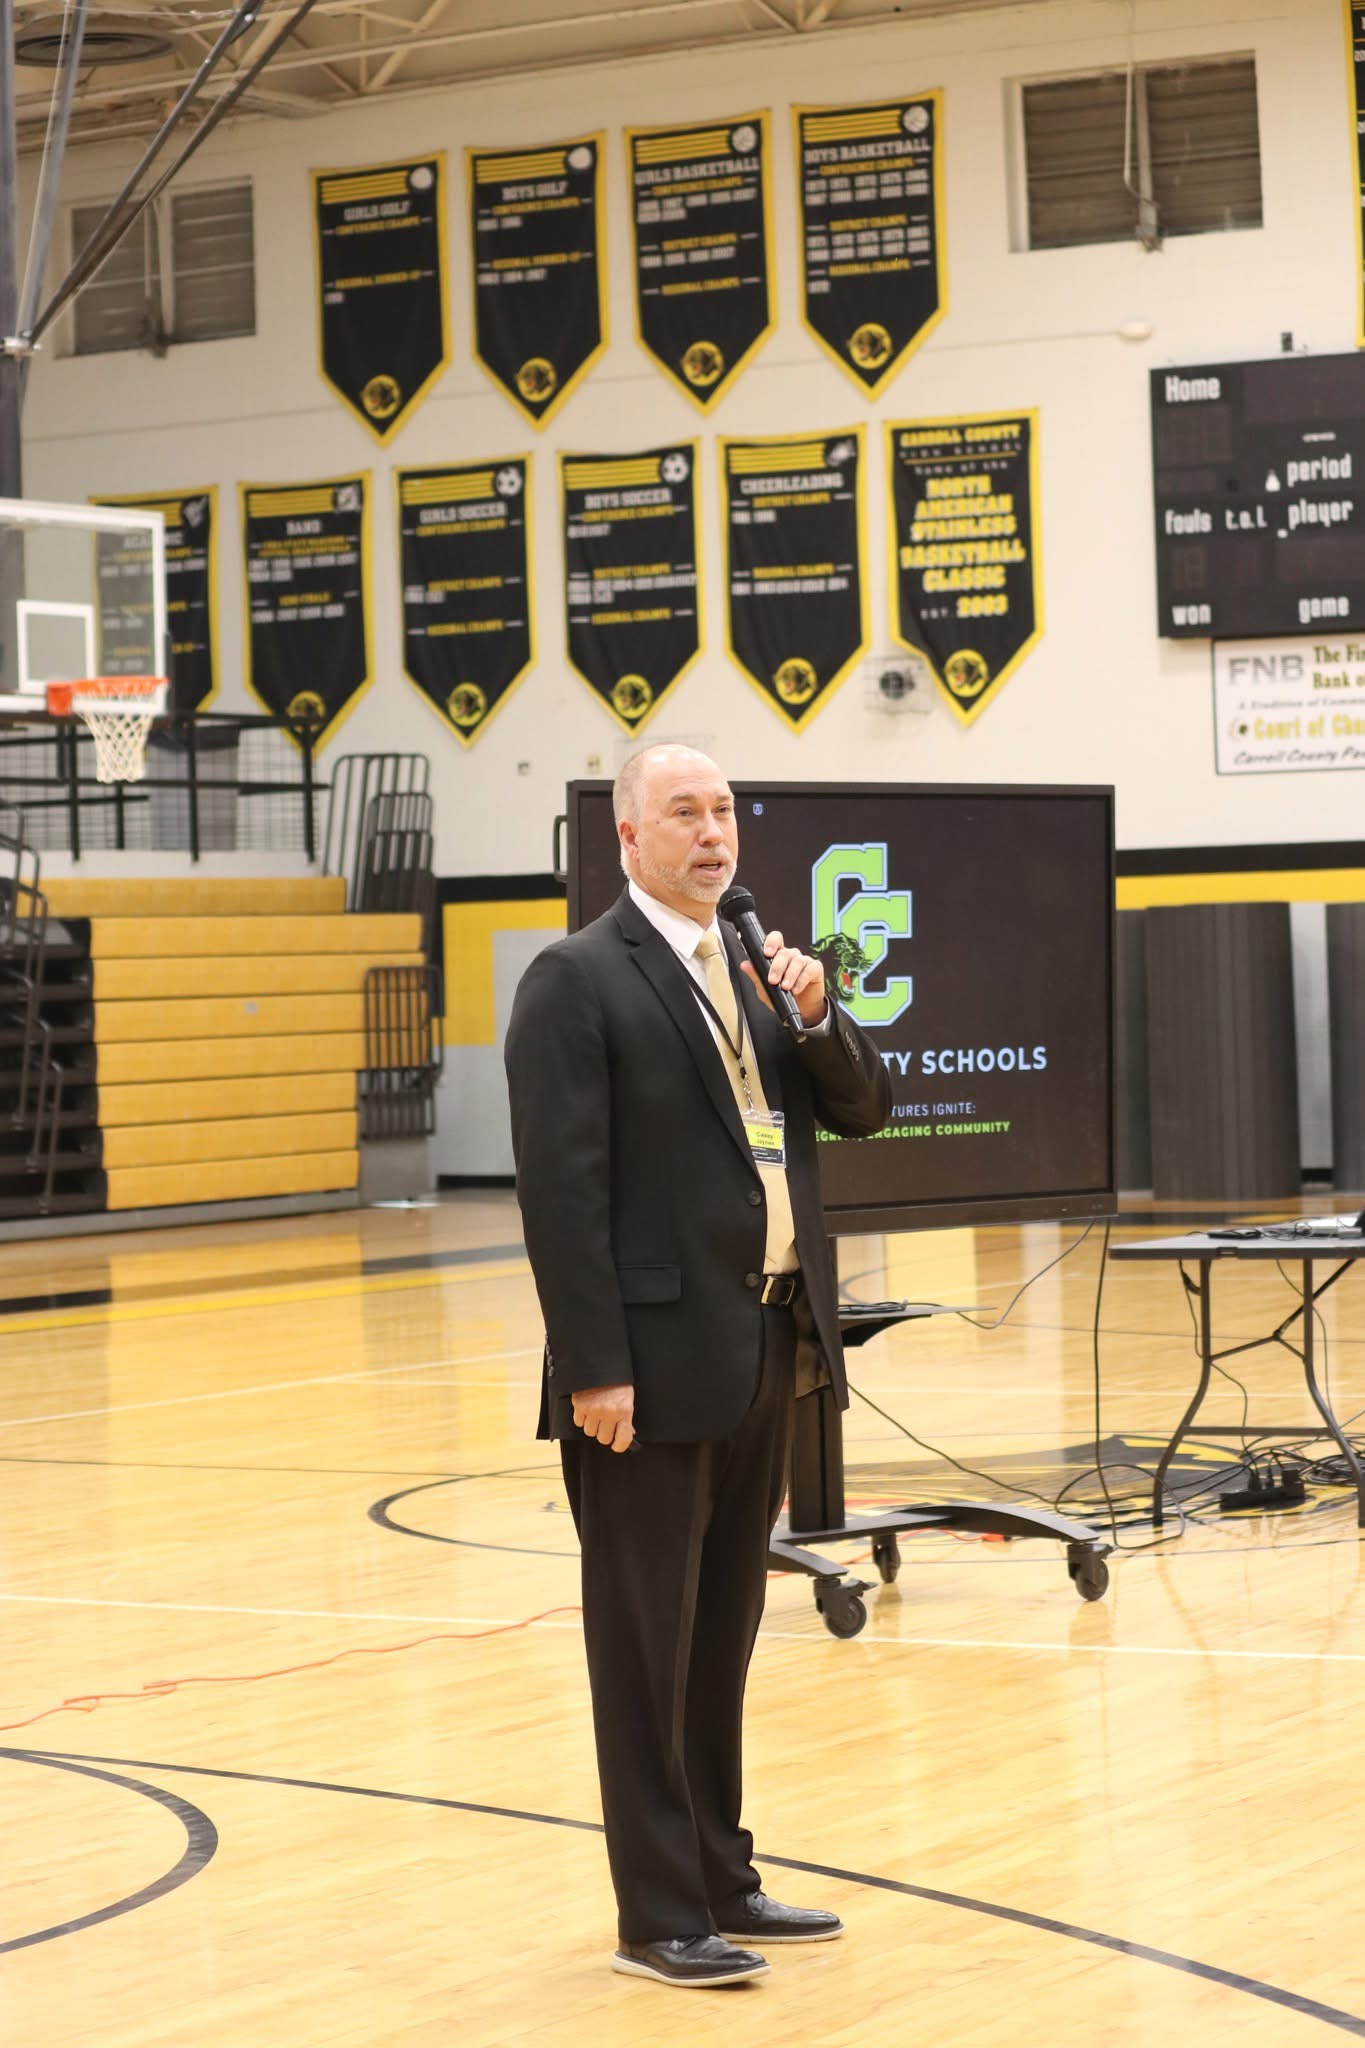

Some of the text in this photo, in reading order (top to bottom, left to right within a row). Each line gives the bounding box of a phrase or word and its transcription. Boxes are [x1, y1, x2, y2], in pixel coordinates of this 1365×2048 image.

[841, 137, 931, 161] BASKETBALL
[673, 156, 759, 180] BASKETBALL
[1165, 376, 1221, 402] Home
[964, 423, 1020, 442] COUNTY
[740, 472, 844, 494] CHEERLEADING
[1287, 453, 1352, 487] period
[926, 474, 991, 500] NORTH
[914, 493, 1013, 520] AMERICAN
[1288, 499, 1353, 530] player
[910, 514, 1017, 542] STAINLESS
[1165, 508, 1212, 534] fouls
[900, 537, 1026, 569] BASKETBALL
[922, 564, 1006, 593] CLASSIC
[1172, 604, 1211, 625] won
[1299, 597, 1349, 624] game
[1313, 645, 1340, 664] The
[1229, 655, 1304, 685] FNB
[1313, 671, 1350, 689] Bank
[1254, 716, 1300, 740] Court
[922, 1046, 1048, 1075] SCHOOLS
[932, 1102, 976, 1116] IGNITE:
[867, 1125, 932, 1140] NGAGING
[935, 1121, 1011, 1137] COMMUNITY
